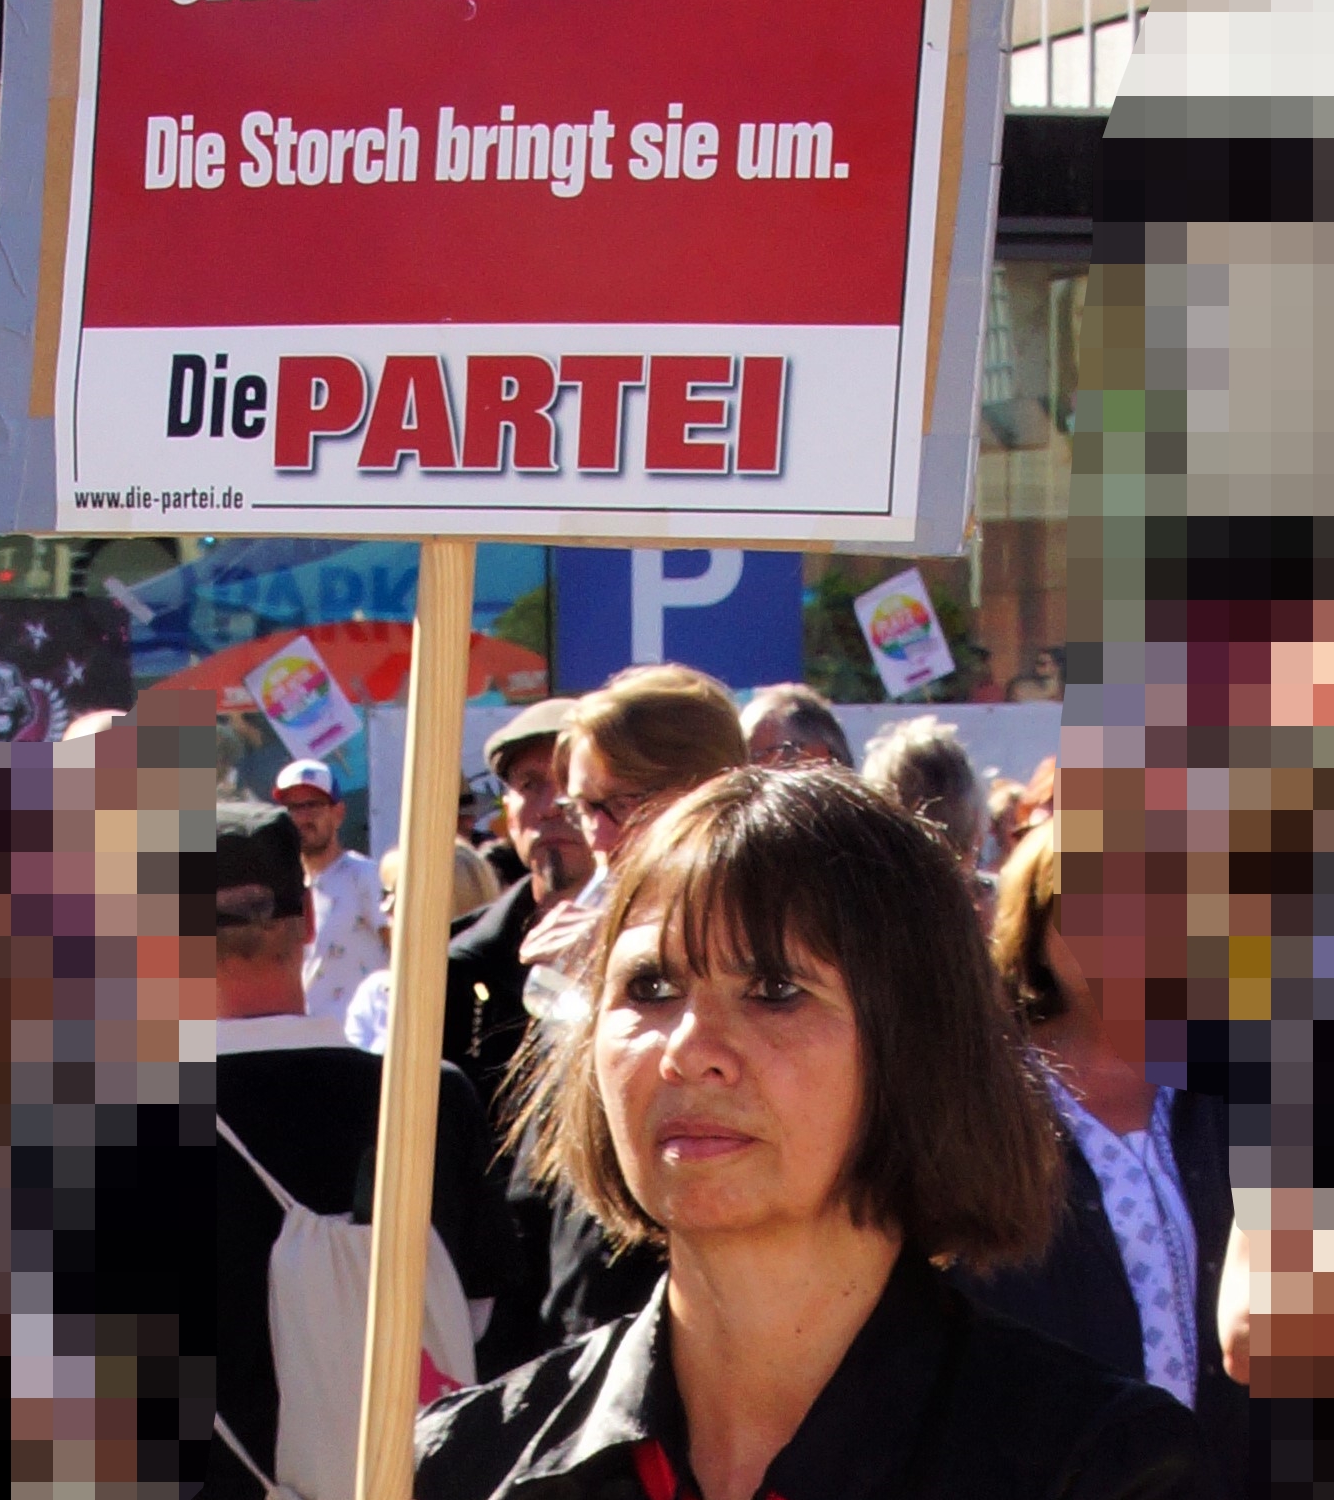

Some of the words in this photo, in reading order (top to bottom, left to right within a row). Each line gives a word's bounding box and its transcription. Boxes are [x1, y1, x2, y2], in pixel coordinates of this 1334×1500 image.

[145, 114, 225, 190] Die
[240, 107, 419, 187] Storch
[435, 105, 614, 198] bringt
[629, 103, 719, 180] sie
[737, 119, 849, 180] um.
[272, 353, 787, 473] PARTEI
[75, 486, 244, 514] www.die-partei.de
